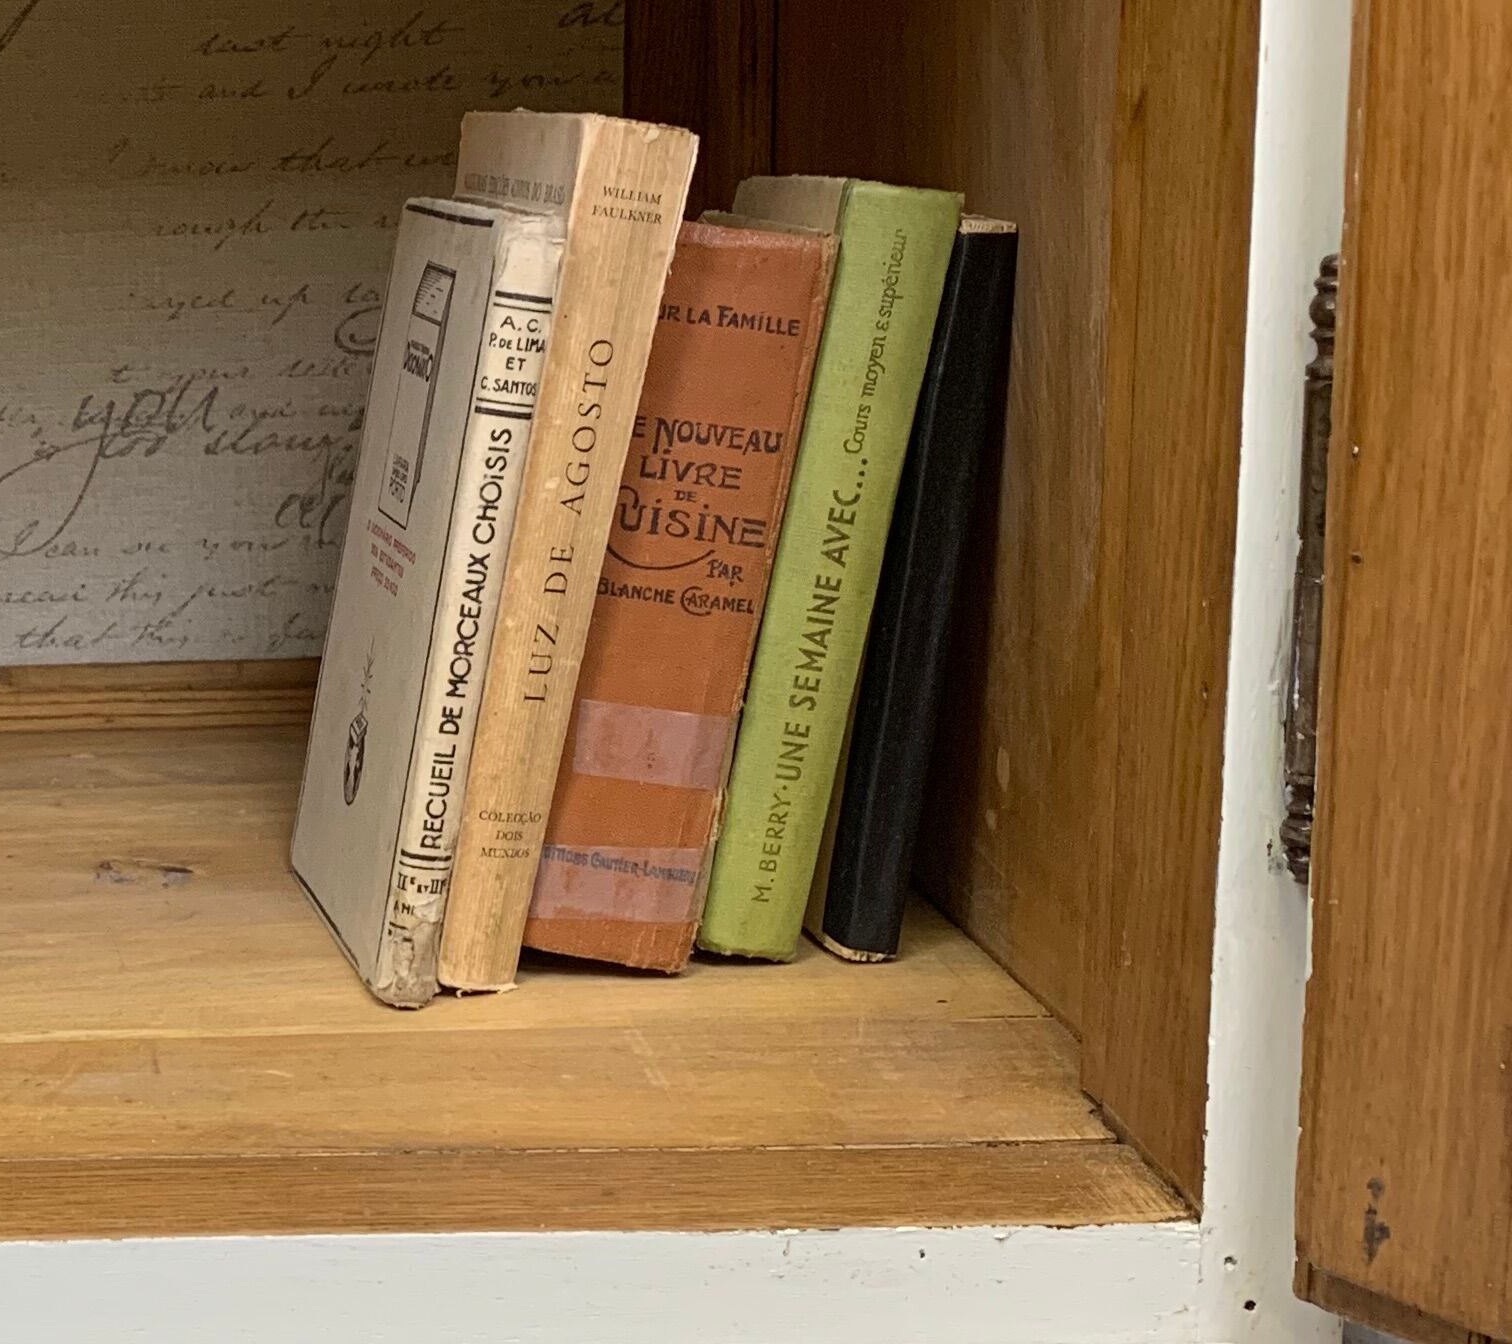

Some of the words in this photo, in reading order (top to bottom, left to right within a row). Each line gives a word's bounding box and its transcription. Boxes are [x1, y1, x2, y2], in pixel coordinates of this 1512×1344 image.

[602, 185, 662, 206] WILLIAM
[591, 205, 662, 225] FAULKNER
[878, 227, 910, 308] supérieur
[658, 304, 680, 322] UR
[688, 308, 712, 325] LA
[516, 336, 546, 354] LIMA
[505, 356, 528, 372] ET
[858, 326, 890, 398] moyen
[632, 415, 646, 439] E
[653, 416, 783, 455] NOUVEAU
[843, 402, 872, 455] Cours
[640, 452, 743, 490] LIVRE
[674, 489, 697, 503] DE
[522, 621, 560, 705] LUZ
[543, 543, 576, 600] DE
[560, 338, 615, 518] AGOSTO
[707, 558, 744, 587] PAR
[598, 576, 676, 605] BLANCHE
[445, 551, 492, 698] MORCEAUX
[789, 571, 845, 712] SEMAINE
[439, 705, 463, 736] DE
[775, 714, 814, 782] UNE
[419, 742, 456, 849] RECUEIL
[495, 830, 524, 842] DOIS
[480, 846, 530, 859] MUNDOS
